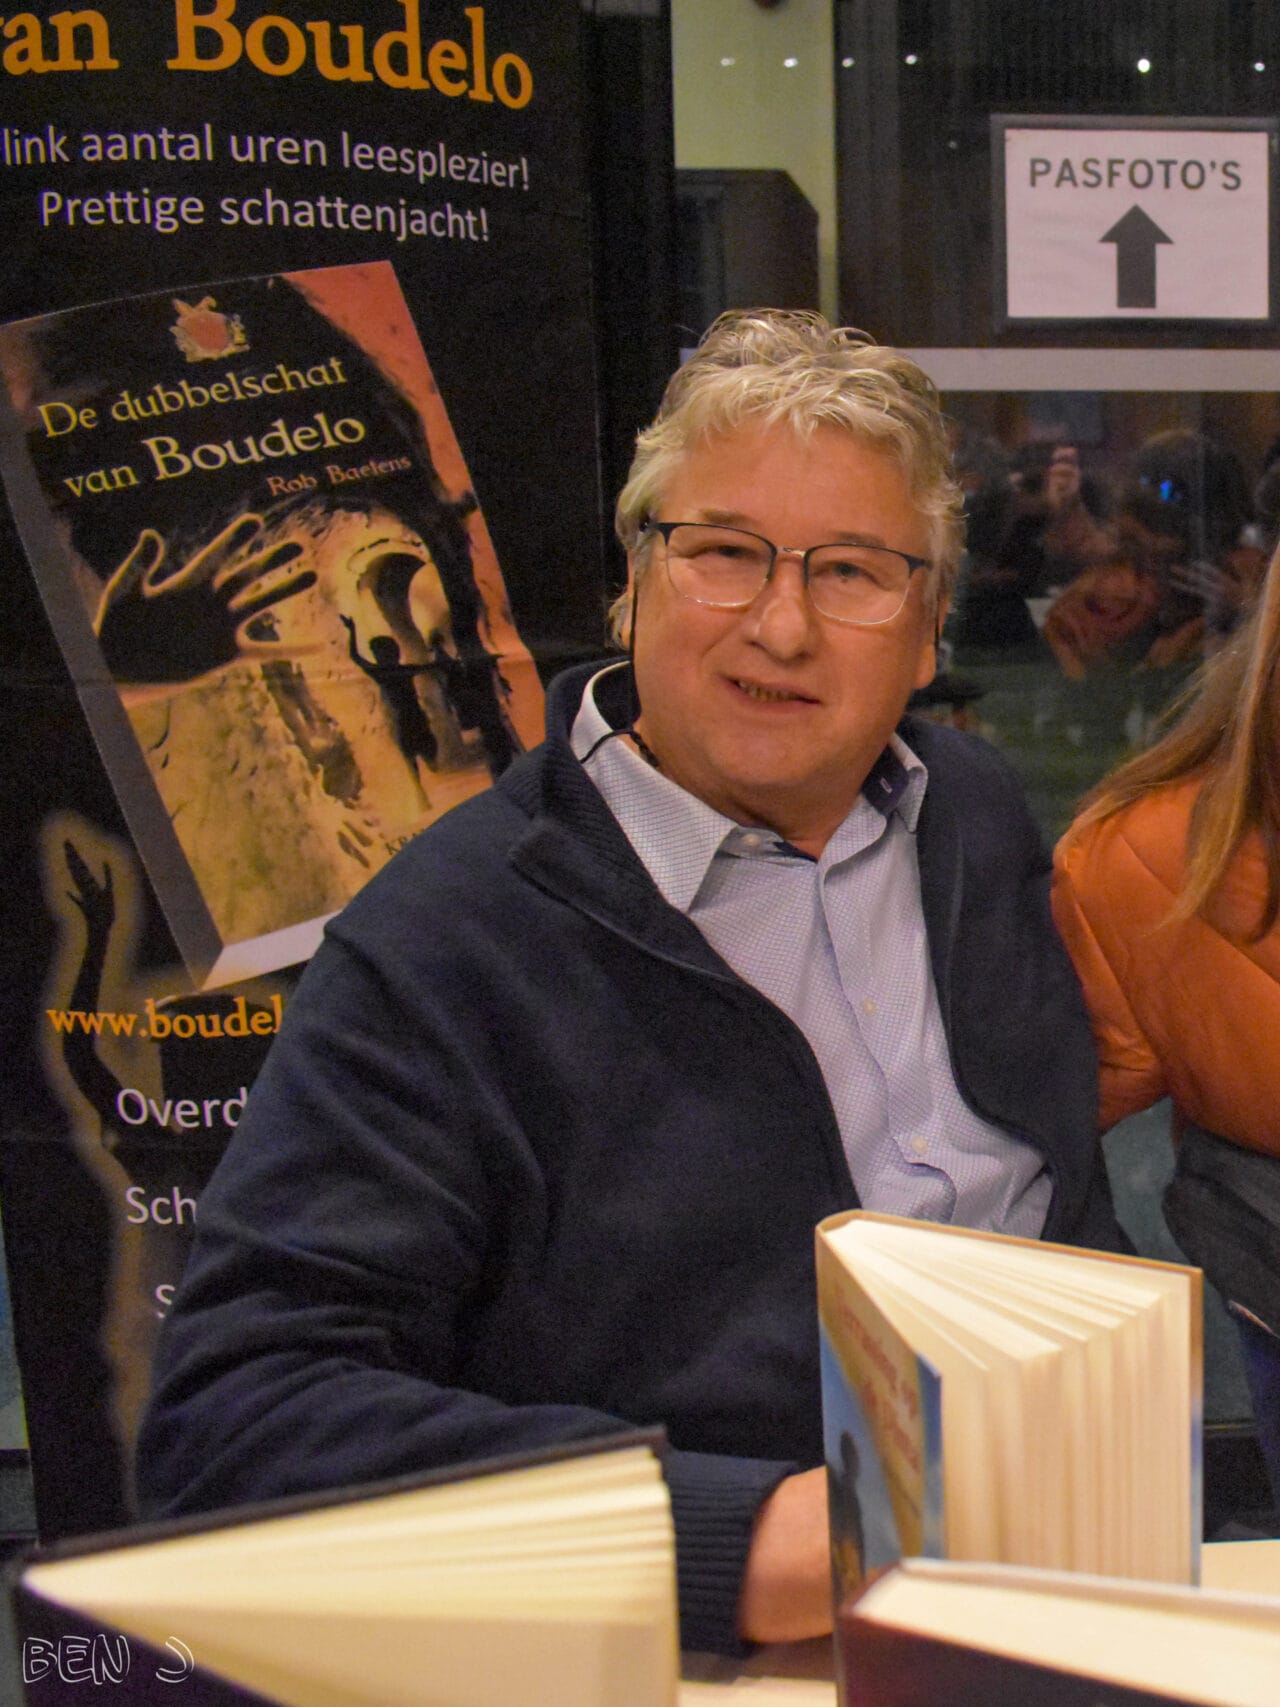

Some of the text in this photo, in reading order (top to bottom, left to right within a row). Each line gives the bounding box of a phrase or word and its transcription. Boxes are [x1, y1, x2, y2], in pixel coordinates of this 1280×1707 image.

[0, 0, 533, 109] an Boudelo
[0, 124, 530, 190] link aantal uren leesplezier!
[1030, 158, 1241, 190] PASFOTO'S
[42, 188, 489, 242] Prettige schattenjacht!
[39, 357, 347, 437] De dubbelschat
[64, 413, 365, 497] van Boudelo
[266, 456, 412, 496] Rob Baetens
[47, 994, 282, 1038] www.boudel
[117, 1087, 247, 1128] Overd
[126, 1187, 197, 1225] Sch
